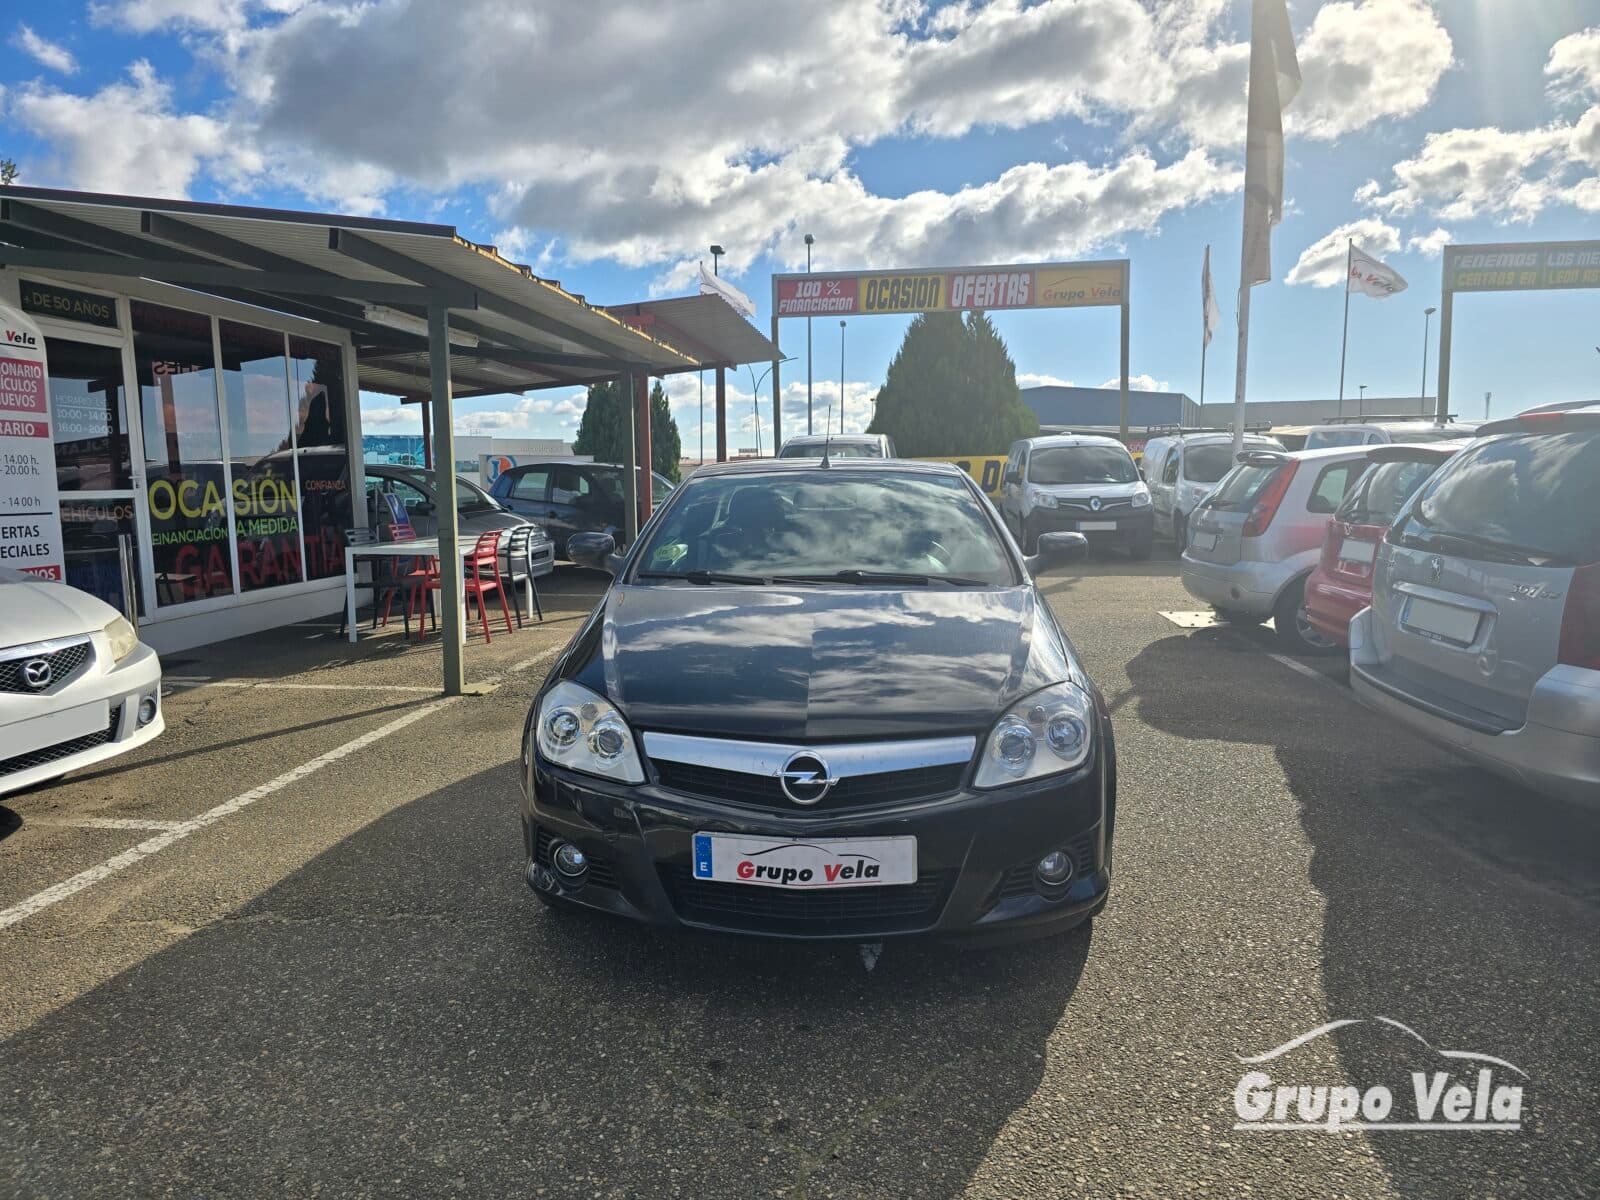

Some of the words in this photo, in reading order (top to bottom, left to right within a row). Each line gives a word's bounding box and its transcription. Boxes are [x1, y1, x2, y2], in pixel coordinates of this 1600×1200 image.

[795, 281, 821, 298] 100
[826, 280, 841, 295] %
[865, 277, 941, 310] OCASION
[952, 272, 1031, 308] OFERTAS
[1043, 287, 1085, 302] Grupo
[1091, 286, 1122, 299] Vela
[33, 292, 50, 307] DE
[53, 296, 71, 311] 50
[73, 298, 110, 318] AÑOS
[778, 296, 853, 313] FINANCIACION
[6, 330, 36, 345] Vela
[0, 392, 36, 408] UEVOS
[148, 470, 298, 521] OCASIÓN
[60, 504, 134, 522] EHÍCULOS
[1, 524, 40, 539] ERTAS
[236, 519, 247, 537] A
[249, 516, 299, 536] MEDIDA
[0, 543, 50, 559] ECIALES
[699, 861, 709, 872] E
[736, 860, 813, 885] Grupo
[823, 859, 881, 882] Vela
